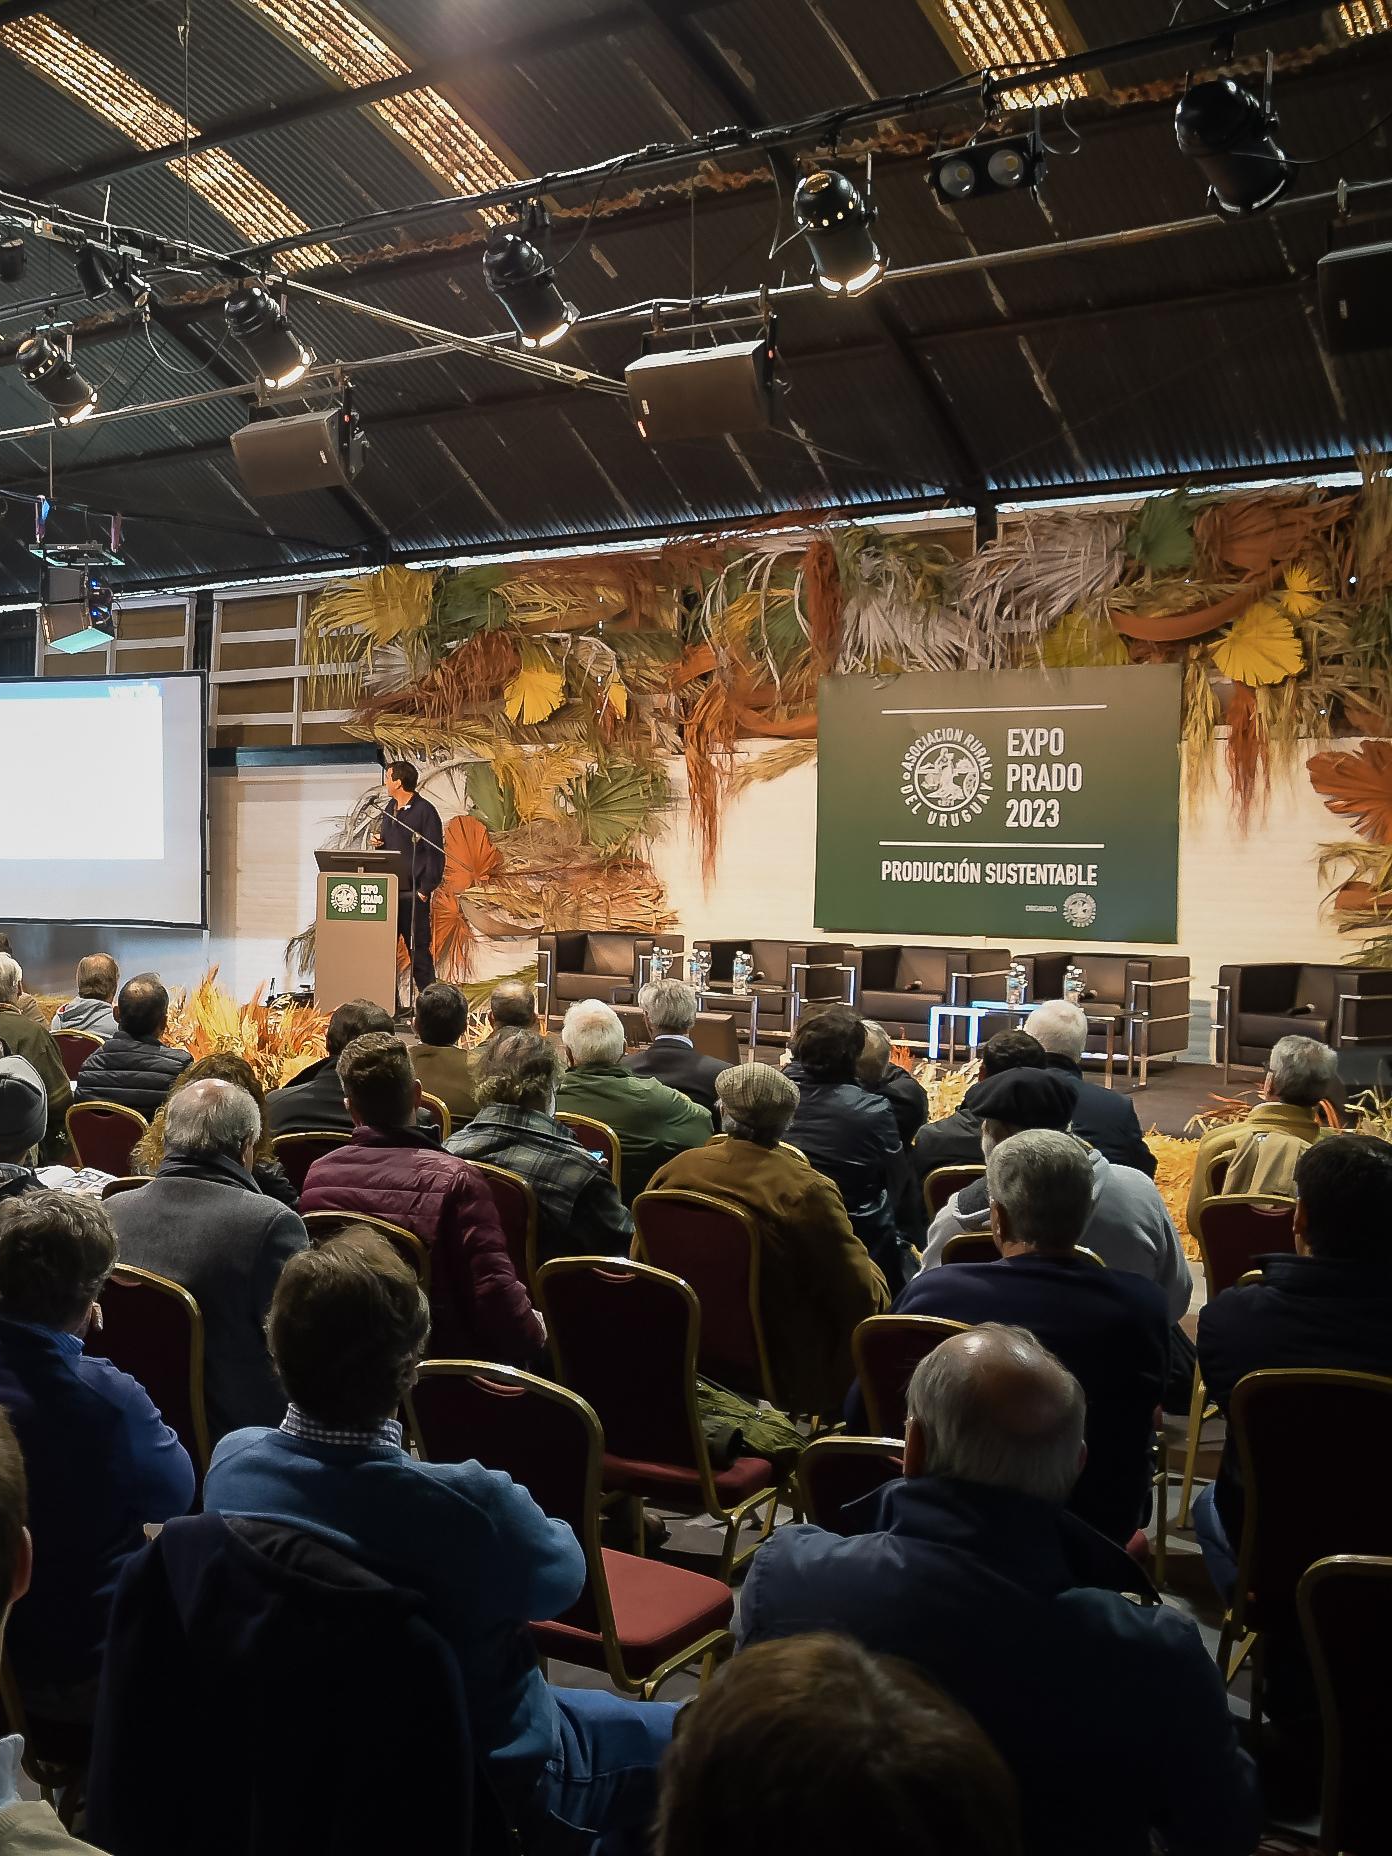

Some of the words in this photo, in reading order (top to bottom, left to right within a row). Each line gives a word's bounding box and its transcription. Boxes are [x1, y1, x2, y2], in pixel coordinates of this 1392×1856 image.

[901, 727, 964, 772] ASOCIACION
[963, 733, 994, 772] RURAL
[1008, 727, 1065, 757] EXPO
[1007, 763, 1083, 792] PRADO
[900, 784, 922, 815] DEL
[927, 782, 994, 827] URUGUAY
[1005, 799, 1060, 828] 2023
[881, 858, 981, 884] PRODUCCIÓN
[985, 863, 1098, 886] SUSTENTABLE
[360, 884, 378, 894] EXPO
[360, 894, 383, 904] PRADO
